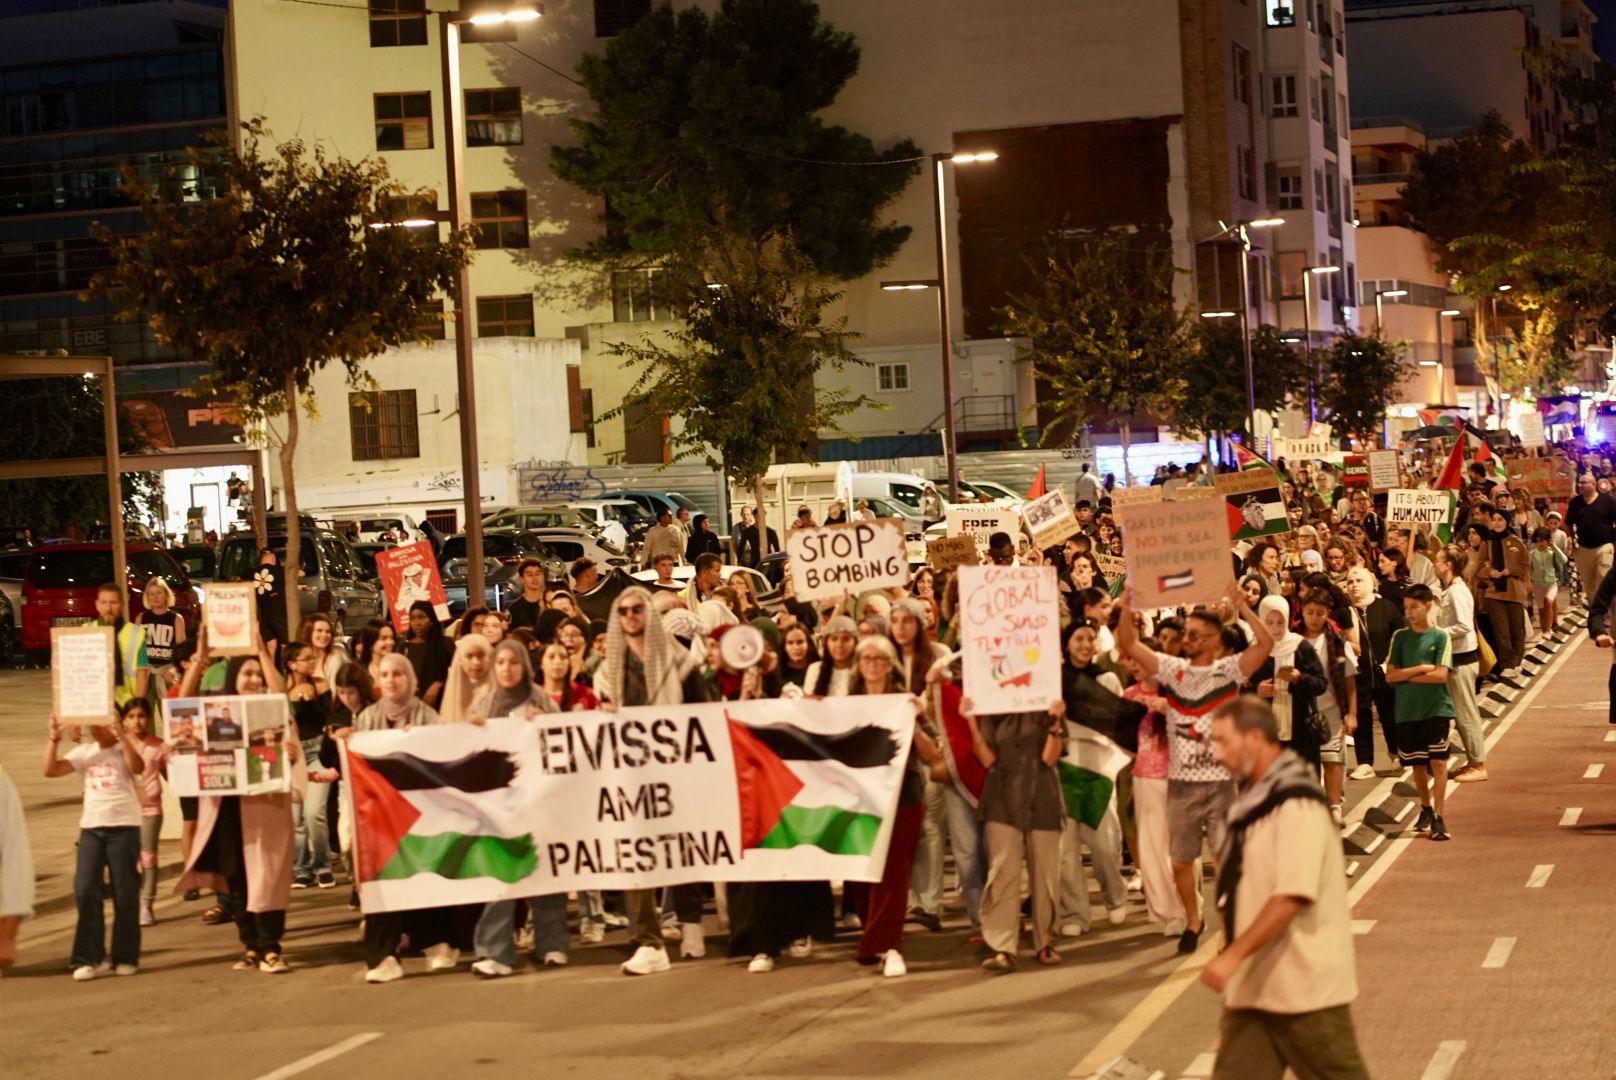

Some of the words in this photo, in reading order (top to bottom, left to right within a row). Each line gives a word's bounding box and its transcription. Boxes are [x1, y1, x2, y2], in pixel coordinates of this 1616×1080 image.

[1416, 494, 1442, 505] ABOUT
[961, 519, 999, 532] FREE
[1393, 507, 1445, 522] HUMANITY
[799, 524, 876, 562] STOP
[1136, 535, 1157, 548] NO
[1187, 529, 1211, 544] SEA
[1099, 555, 1112, 565] UN
[967, 580, 1054, 626] GLOBAL
[539, 717, 716, 775] EIVISSA
[597, 782, 674, 822] AMB
[548, 830, 735, 877] PALESTINA
